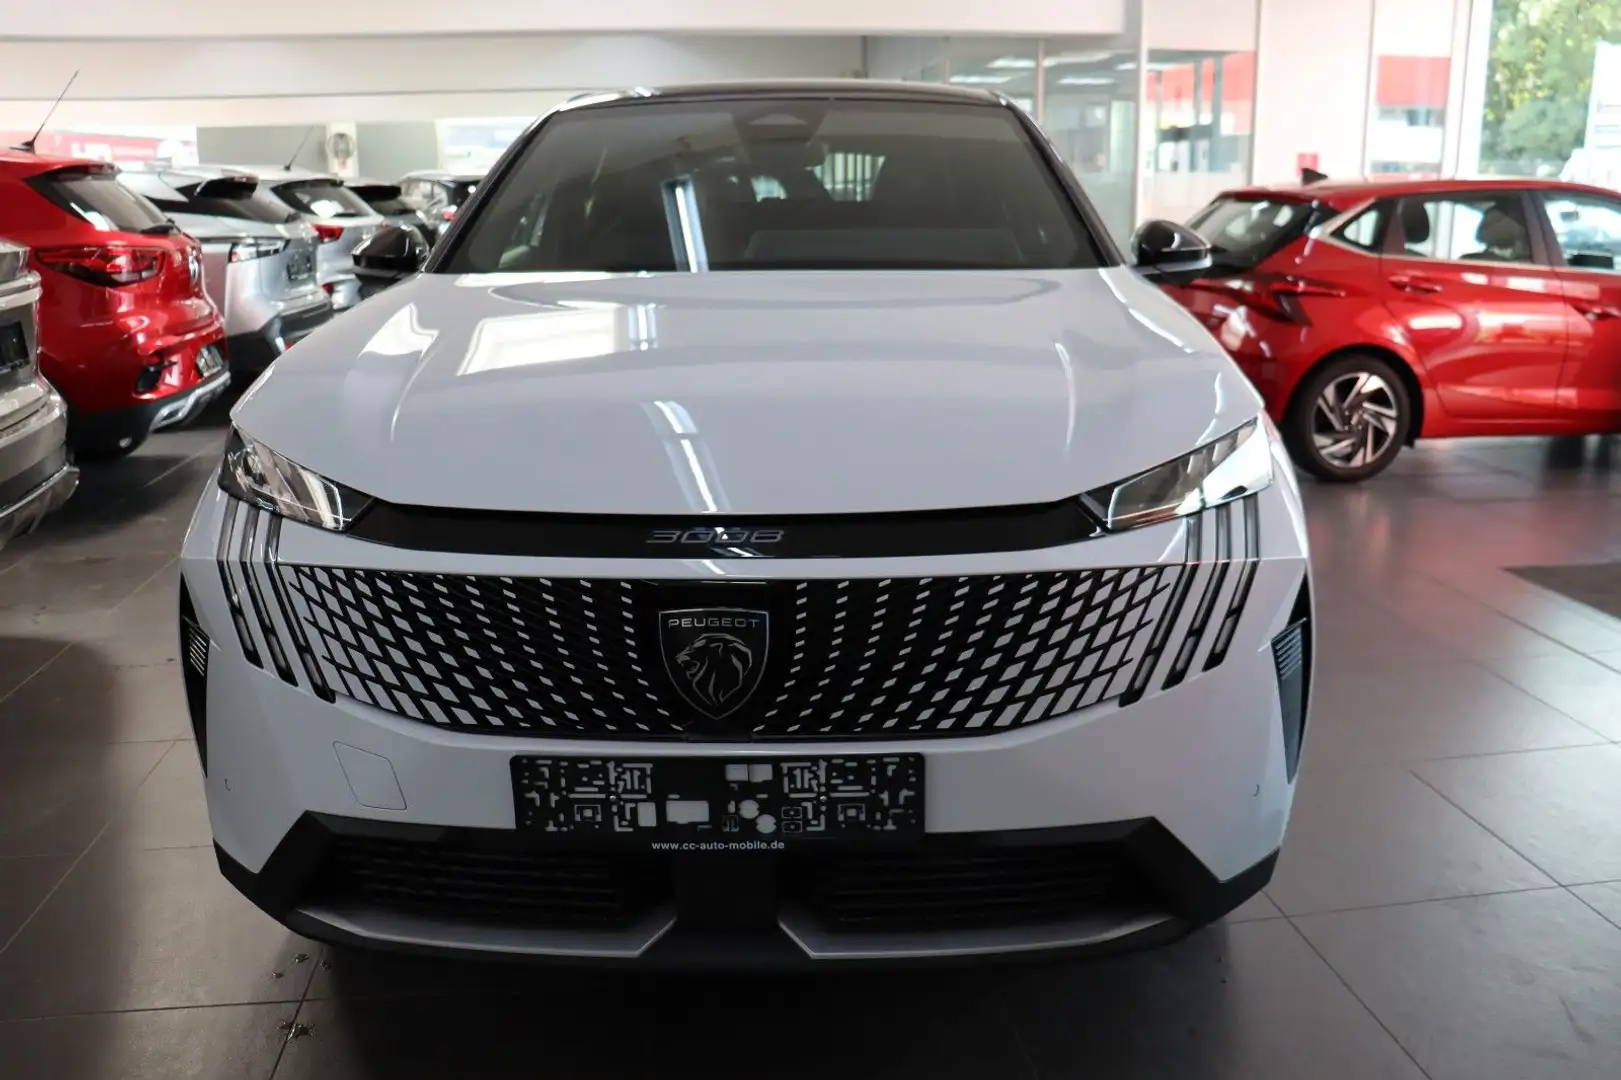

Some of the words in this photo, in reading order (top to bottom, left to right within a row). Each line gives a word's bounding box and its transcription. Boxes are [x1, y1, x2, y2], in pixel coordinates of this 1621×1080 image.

[646, 530, 784, 543] 3008
[668, 617, 760, 628] PEUGEOT
[651, 840, 785, 851] www.cc-auto-mobile.de
